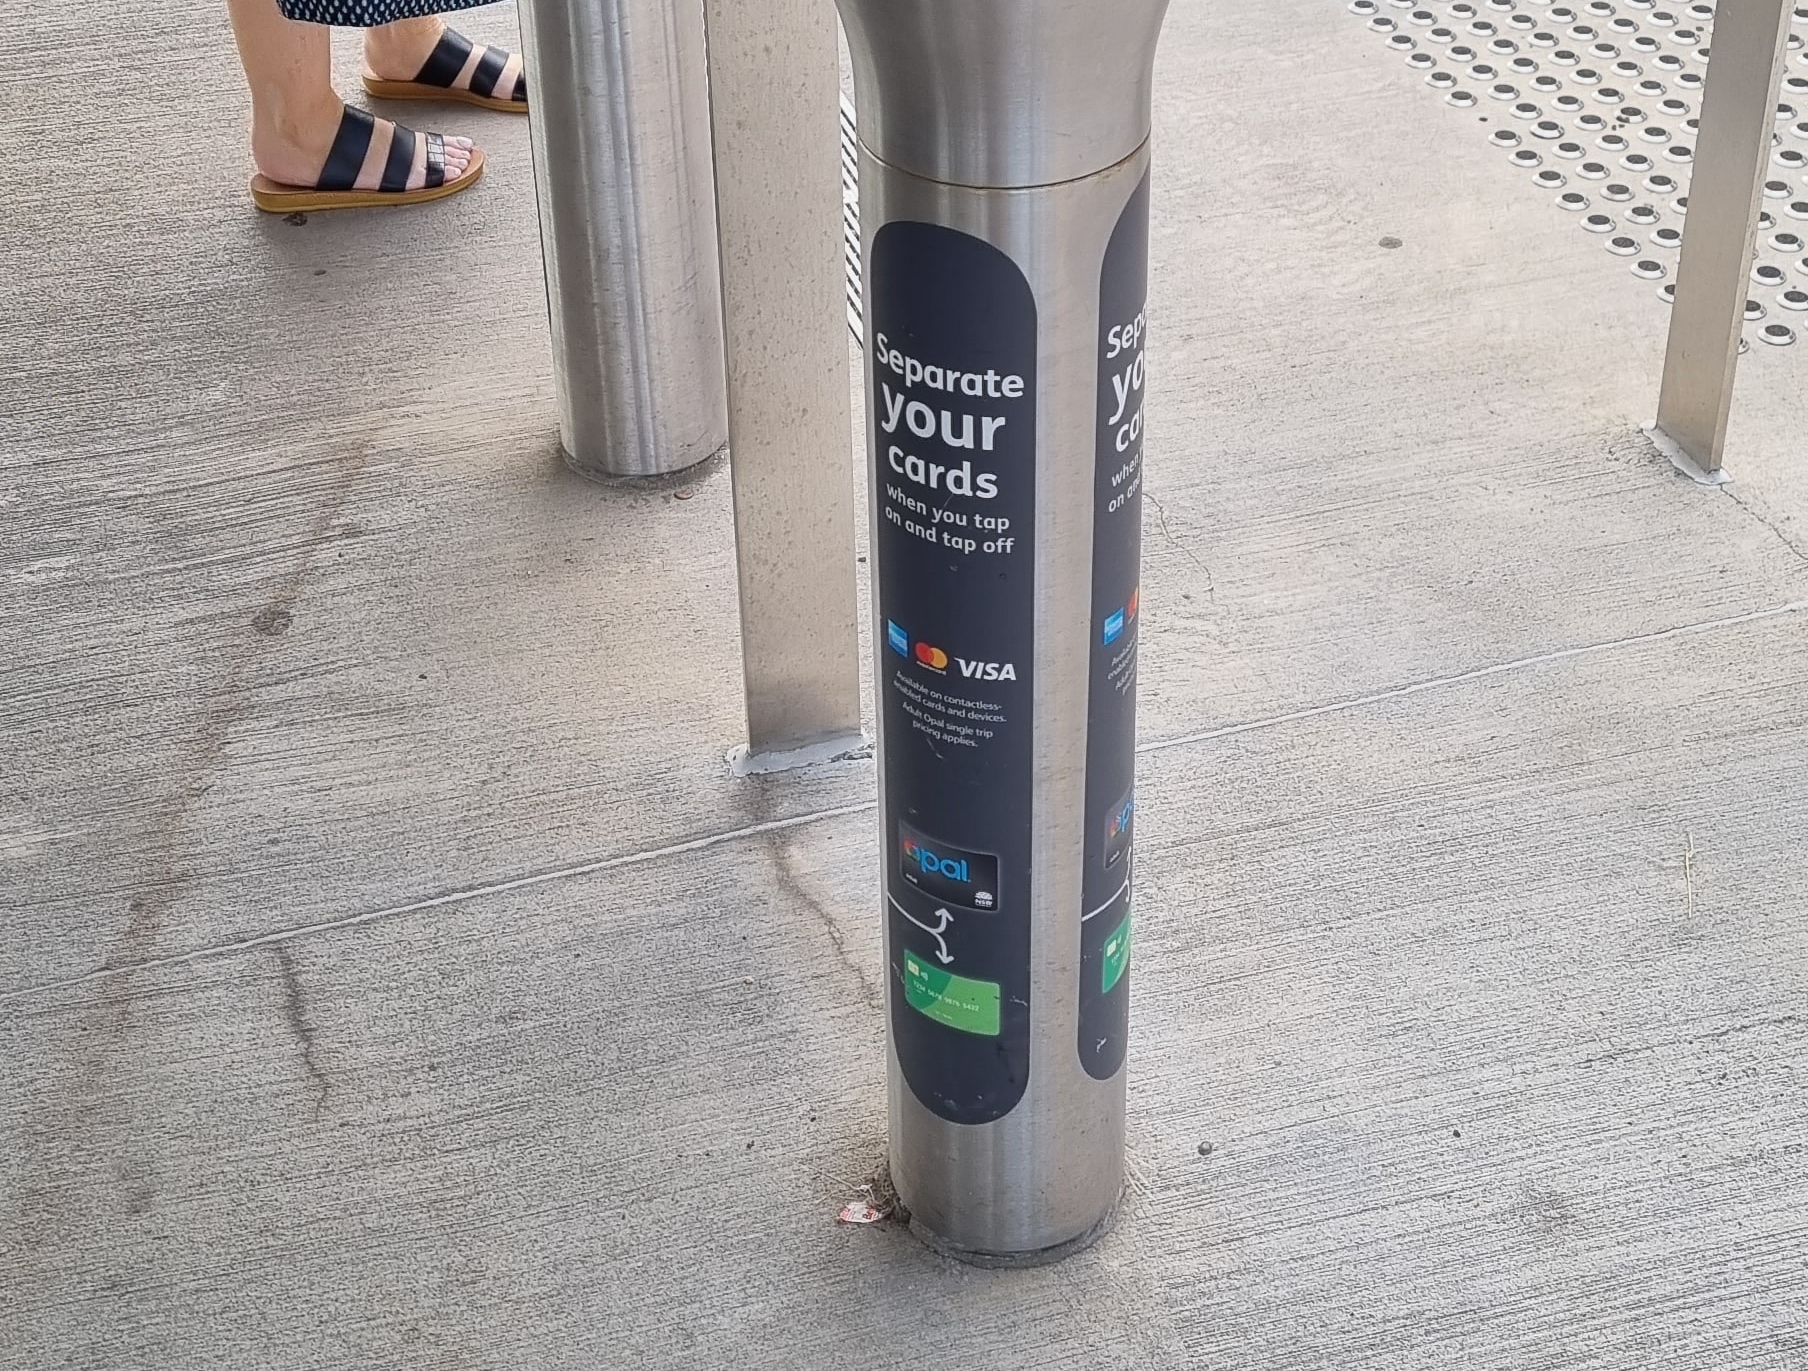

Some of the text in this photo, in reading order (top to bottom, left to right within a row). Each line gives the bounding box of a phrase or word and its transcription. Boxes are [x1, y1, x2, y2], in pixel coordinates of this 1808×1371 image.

[1106, 301, 1147, 358] Sepa
[876, 332, 1025, 398] Separate
[1108, 349, 1144, 425] yo
[881, 382, 1006, 450] your
[888, 445, 999, 499] cards
[1111, 453, 1139, 487] when
[886, 482, 1010, 533] when you tap
[1108, 493, 1124, 513] on
[885, 505, 1015, 554] on and tap off
[954, 657, 1017, 681] VISA
[923, 698, 946, 713] cards
[947, 707, 965, 718] and
[968, 710, 1007, 723] devices.
[930, 690, 942, 700] on
[924, 713, 944, 728] Opal
[946, 722, 973, 736] single
[976, 728, 994, 740] trip
